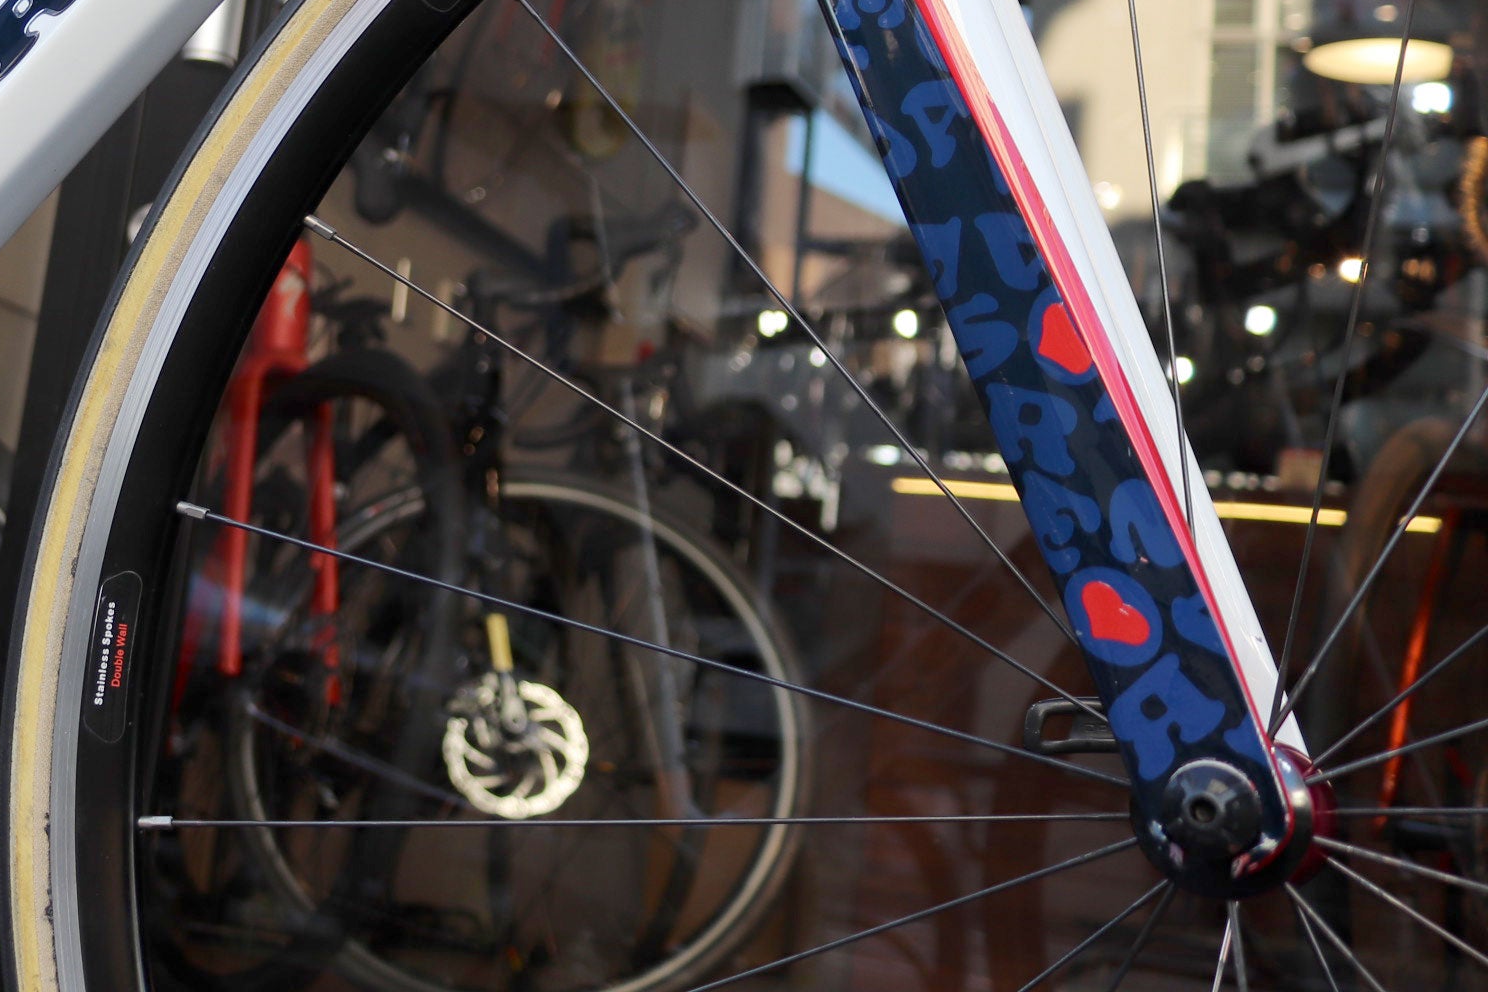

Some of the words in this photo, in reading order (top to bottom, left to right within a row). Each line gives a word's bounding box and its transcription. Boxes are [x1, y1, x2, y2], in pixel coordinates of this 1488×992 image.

[94, 648, 109, 705] Stainless
[102, 602, 115, 645] Spokes
[116, 624, 127, 646] Wall
[111, 649, 124, 687] Double
